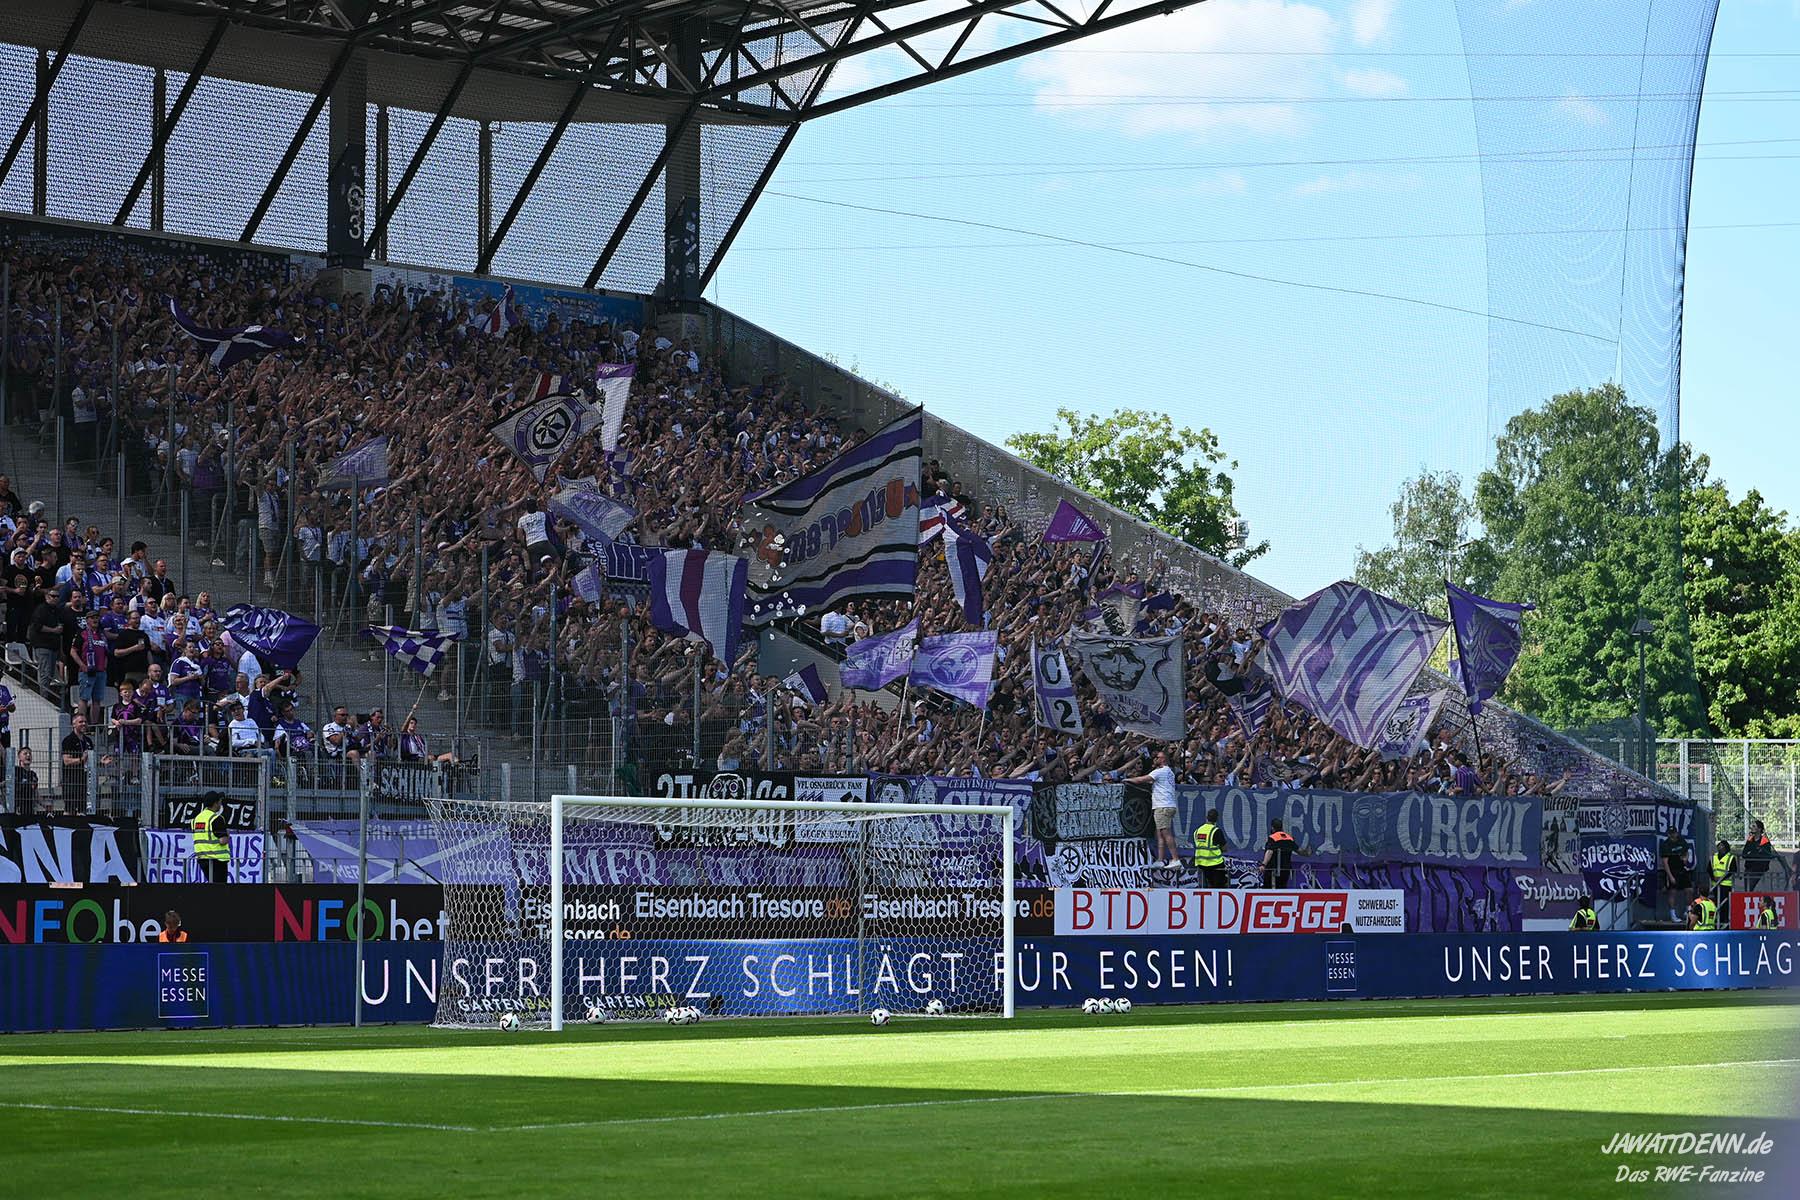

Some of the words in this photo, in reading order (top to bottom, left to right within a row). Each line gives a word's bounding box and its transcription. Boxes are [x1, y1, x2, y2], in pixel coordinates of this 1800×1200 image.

[1397, 792, 1533, 862] CREW
[1578, 810, 1602, 829] HASE
[1629, 809, 1655, 827] STADT
[150, 832, 186, 866] DIE
[524, 898, 620, 920] Eisnbach
[635, 891, 744, 919] Eisenbach
[863, 893, 958, 920] Eisenbach
[1072, 890, 1149, 930] BTD
[1168, 890, 1240, 930] BTD
[1357, 899, 1400, 910] SCHWERLAST-
[1743, 896, 1786, 928] HE
[1355, 915, 1402, 927] NUTZFAHRZEUGE
[1328, 952, 1355, 965] MESSE
[1445, 945, 1554, 983] UNSER
[1573, 943, 1656, 979] HERZ
[1674, 935, 1800, 978] SCHLÄG
[161, 967, 206, 984] MESSE
[578, 955, 712, 999] HERZ
[742, 945, 964, 998] SCHLÄGT
[1100, 948, 1234, 991] ESSEN!
[1328, 967, 1356, 980] ESSEN
[161, 987, 206, 1003] ESSEN
